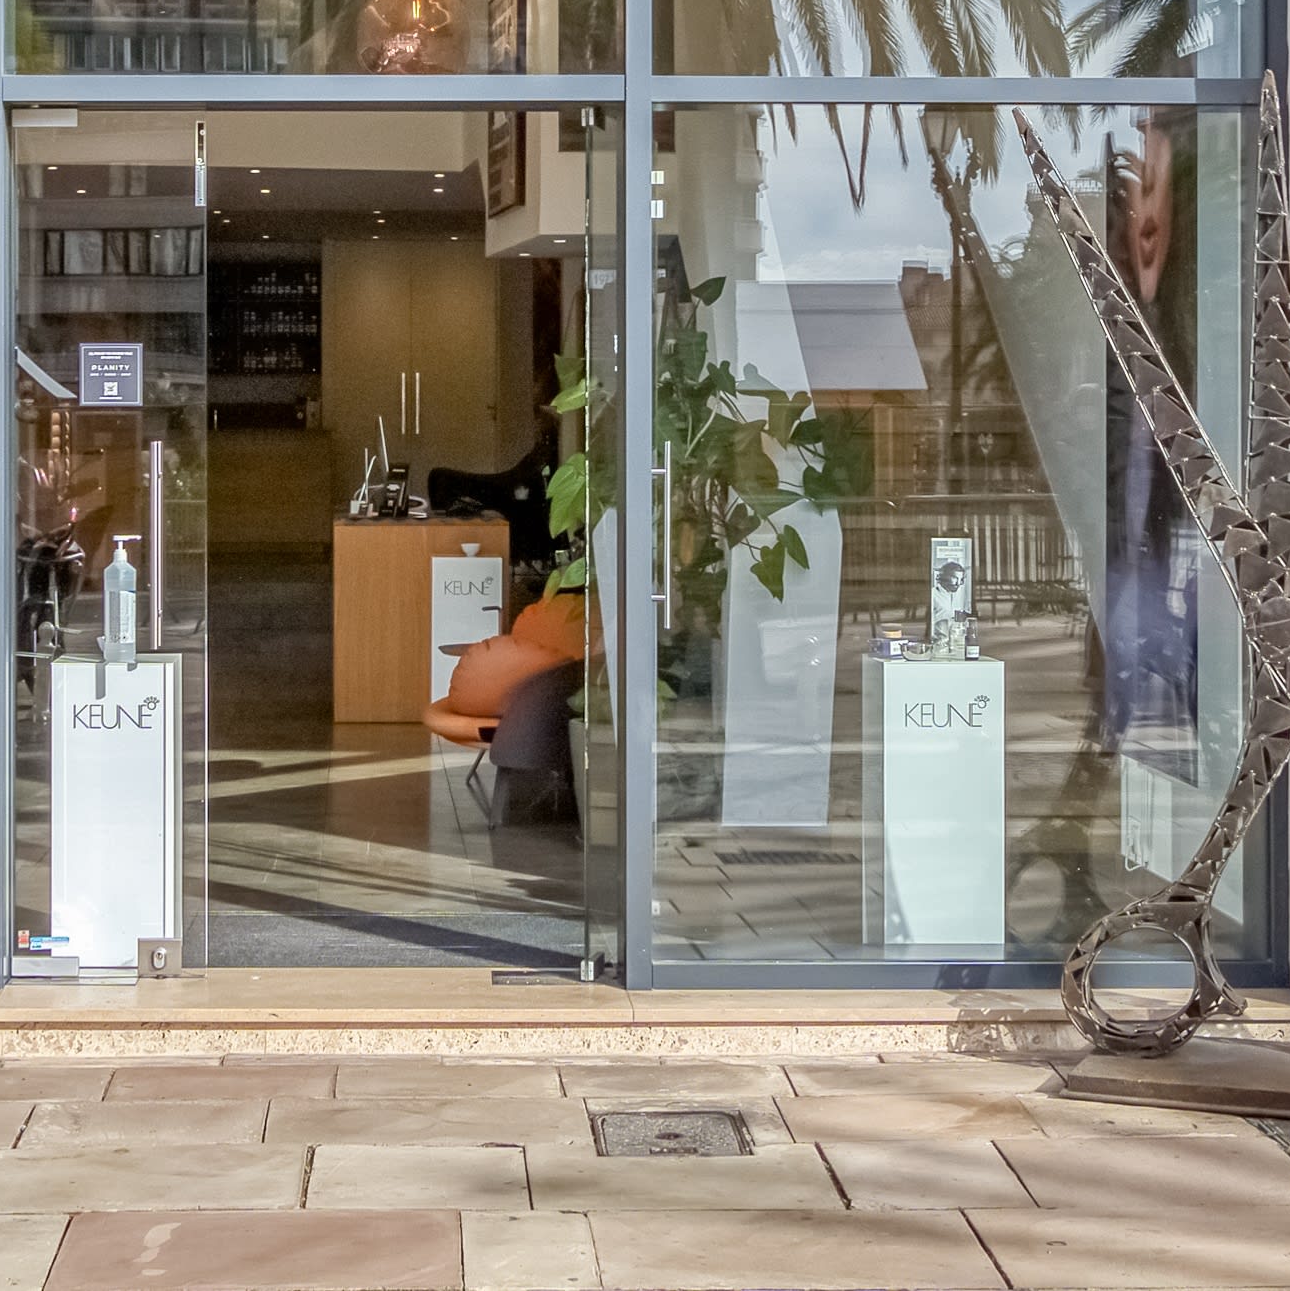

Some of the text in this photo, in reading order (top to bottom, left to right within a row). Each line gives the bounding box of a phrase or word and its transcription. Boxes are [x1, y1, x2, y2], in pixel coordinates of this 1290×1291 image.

[443, 580, 491, 596] KEUNE
[72, 703, 153, 730] KEUNE
[904, 702, 983, 728] KEUNE
